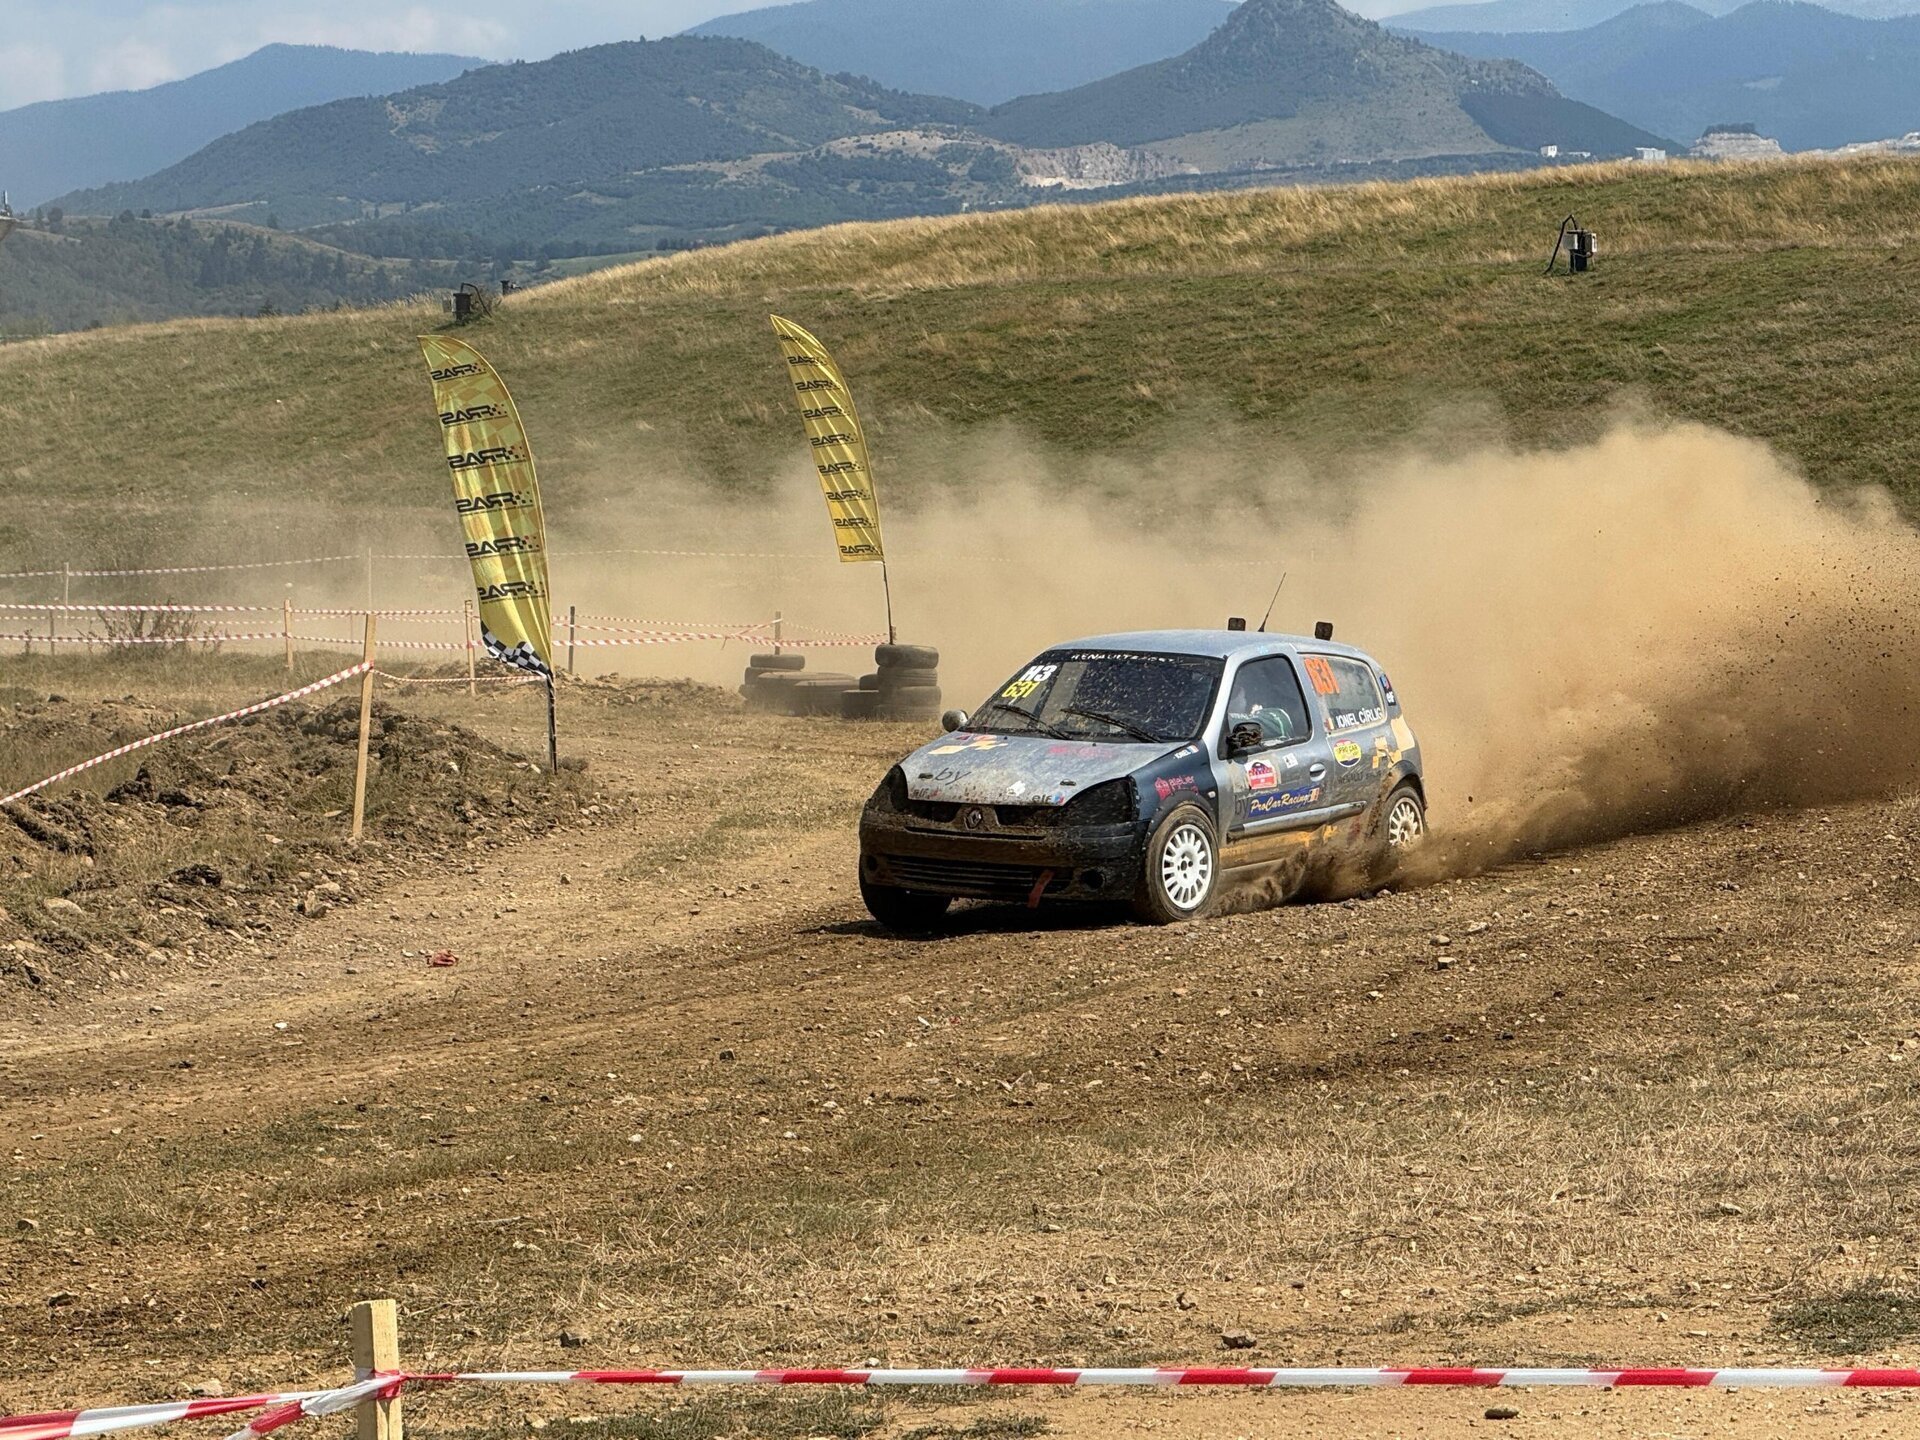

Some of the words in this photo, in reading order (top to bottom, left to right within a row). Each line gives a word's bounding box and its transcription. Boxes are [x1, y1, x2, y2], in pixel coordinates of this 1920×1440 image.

[1018, 664, 1057, 681] H3
[1304, 657, 1340, 696] 631
[1001, 681, 1041, 698] 631
[1335, 713, 1360, 728] IONEL
[932, 768, 972, 786] by
[1032, 794, 1053, 804] elf
